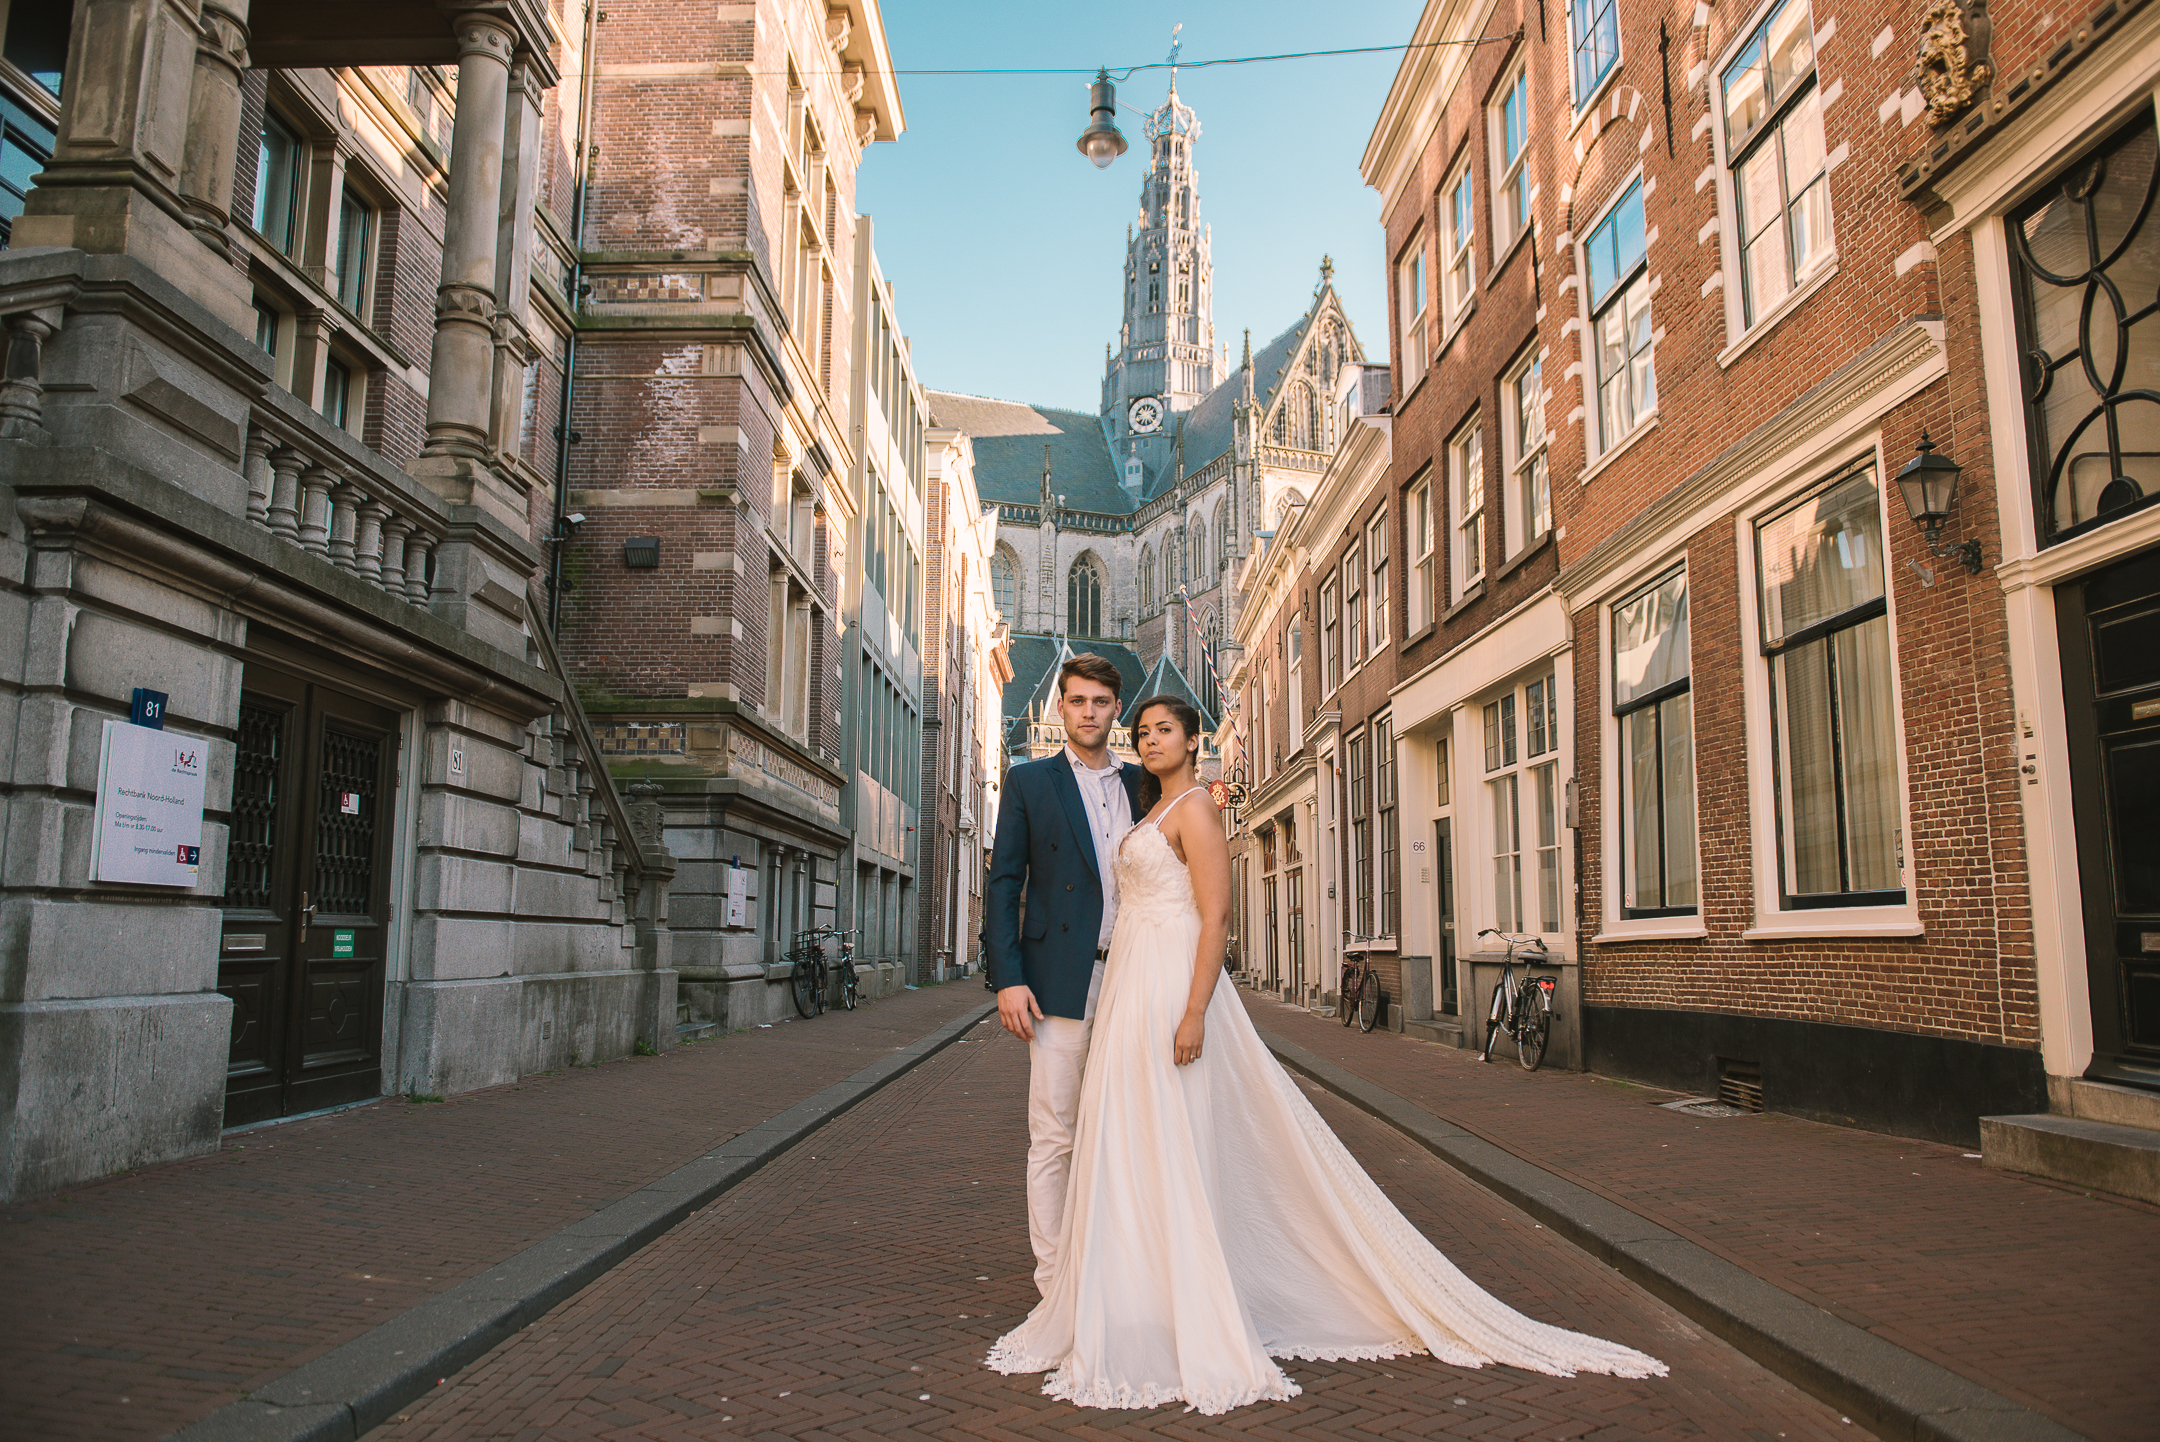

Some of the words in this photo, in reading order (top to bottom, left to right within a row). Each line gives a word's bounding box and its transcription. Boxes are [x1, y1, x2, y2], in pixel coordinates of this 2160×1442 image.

[145, 701, 160, 718] 81
[453, 751, 462, 771] 81
[118, 787, 146, 799] Rechtbank
[147, 793, 184, 805] Noord-Holland
[1412, 841, 1425, 852] 66
